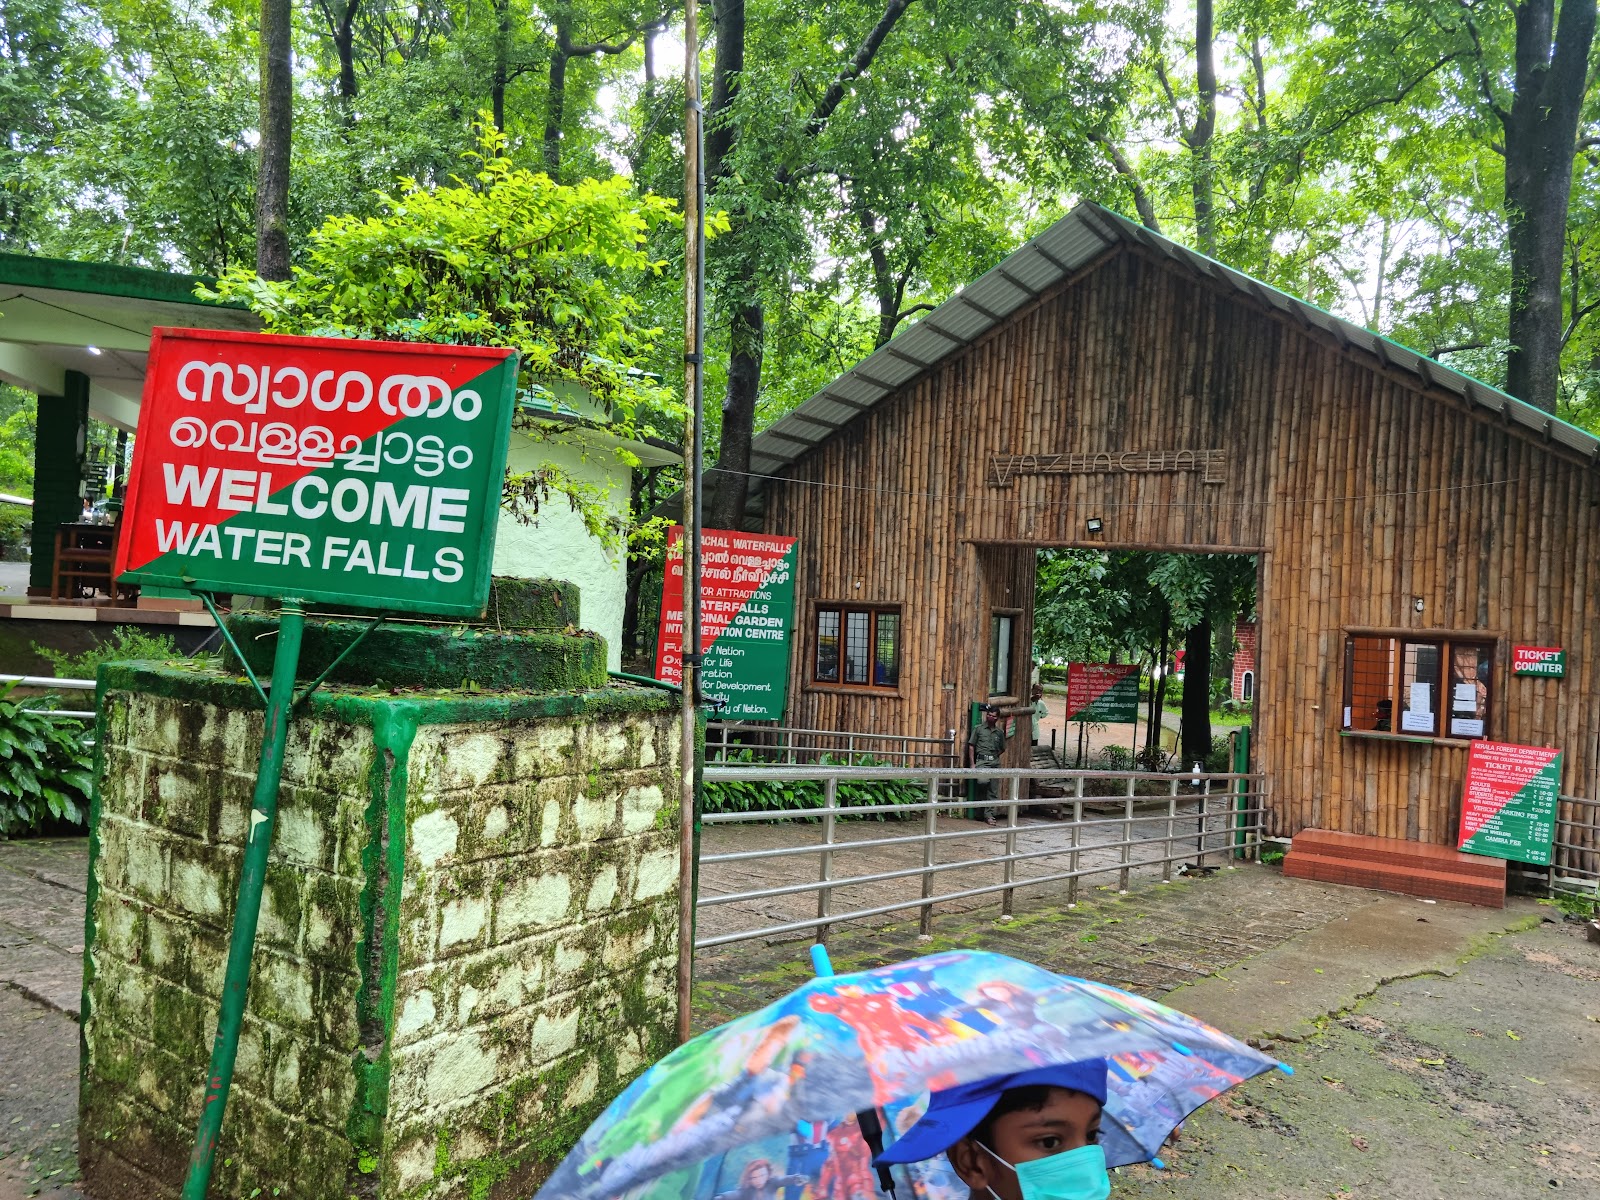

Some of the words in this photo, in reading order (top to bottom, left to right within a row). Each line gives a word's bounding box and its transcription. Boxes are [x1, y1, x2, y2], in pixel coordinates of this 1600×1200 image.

[176, 361, 482, 421] സ്വാഗതം
[992, 450, 1225, 486] VAZHACHAL
[162, 463, 470, 534] WELCOME
[155, 519, 311, 568] WATER
[322, 536, 464, 582] FALLS
[733, 539, 792, 554] WATERFALLS
[716, 588, 772, 600] ATTRACTIONS
[701, 600, 768, 614] ATERFALLS
[735, 616, 784, 628] GARDEN
[745, 629, 784, 640] CENTRE
[702, 645, 714, 654] of
[716, 646, 744, 656] Nation
[1518, 650, 1561, 661] TICKET
[704, 657, 716, 666] for
[720, 658, 732, 667] Life
[1514, 661, 1562, 673] COUNTER
[702, 680, 714, 689] for
[716, 681, 772, 692] Development
[733, 704, 742, 712] of
[1485, 762, 1512, 771] TICKET
[1515, 766, 1543, 775] RATES
[1473, 805, 1497, 813] VEHICLE
[1499, 808, 1525, 817] PARKING
